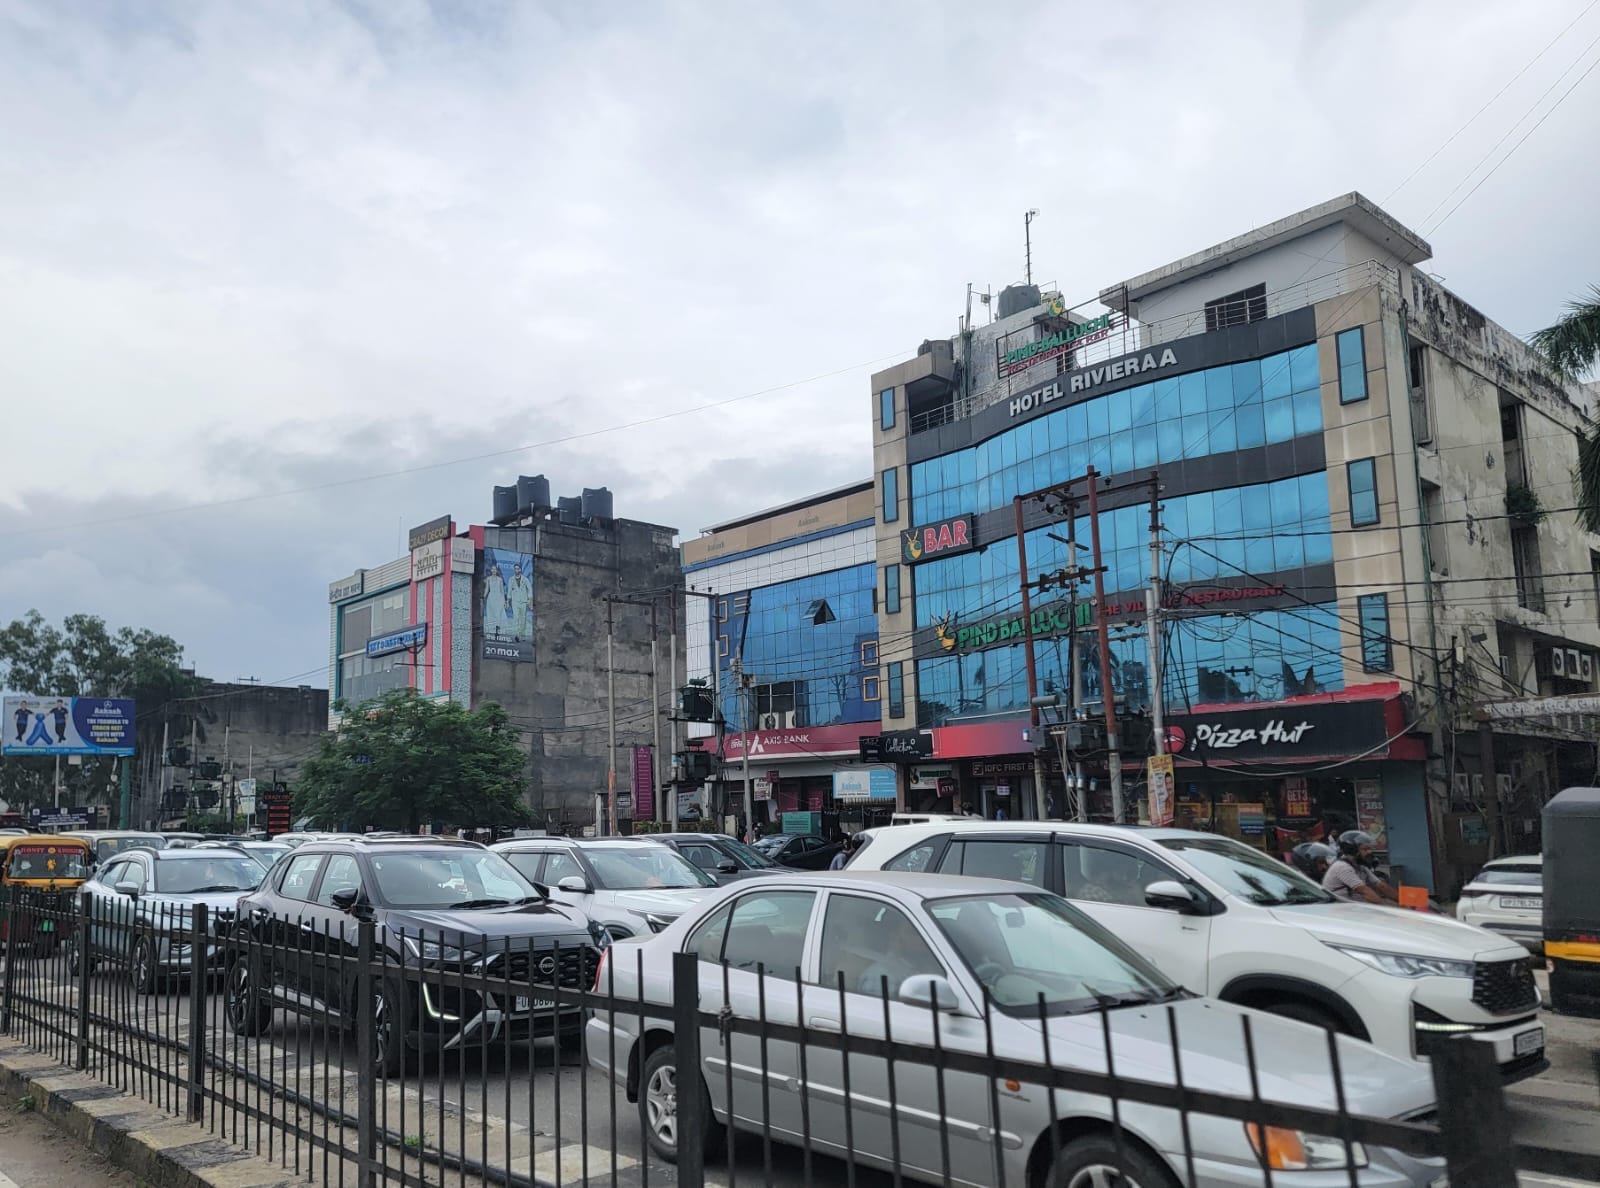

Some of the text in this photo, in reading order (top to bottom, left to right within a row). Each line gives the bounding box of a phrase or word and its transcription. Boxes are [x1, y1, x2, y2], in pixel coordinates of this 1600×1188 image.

[1006, 313, 1110, 364] PIND BALLUCHI
[1009, 348, 1178, 417] HOTEL RIVIERAA
[923, 520, 969, 553] BAR
[958, 622, 998, 648] PIND
[497, 648, 520, 657] max
[764, 734, 810, 745] AXIS BANK
[1190, 719, 1316, 752] Pizza Hut
[1004, 762, 1027, 771] FIRST
[941, 785, 954, 793] ATM
